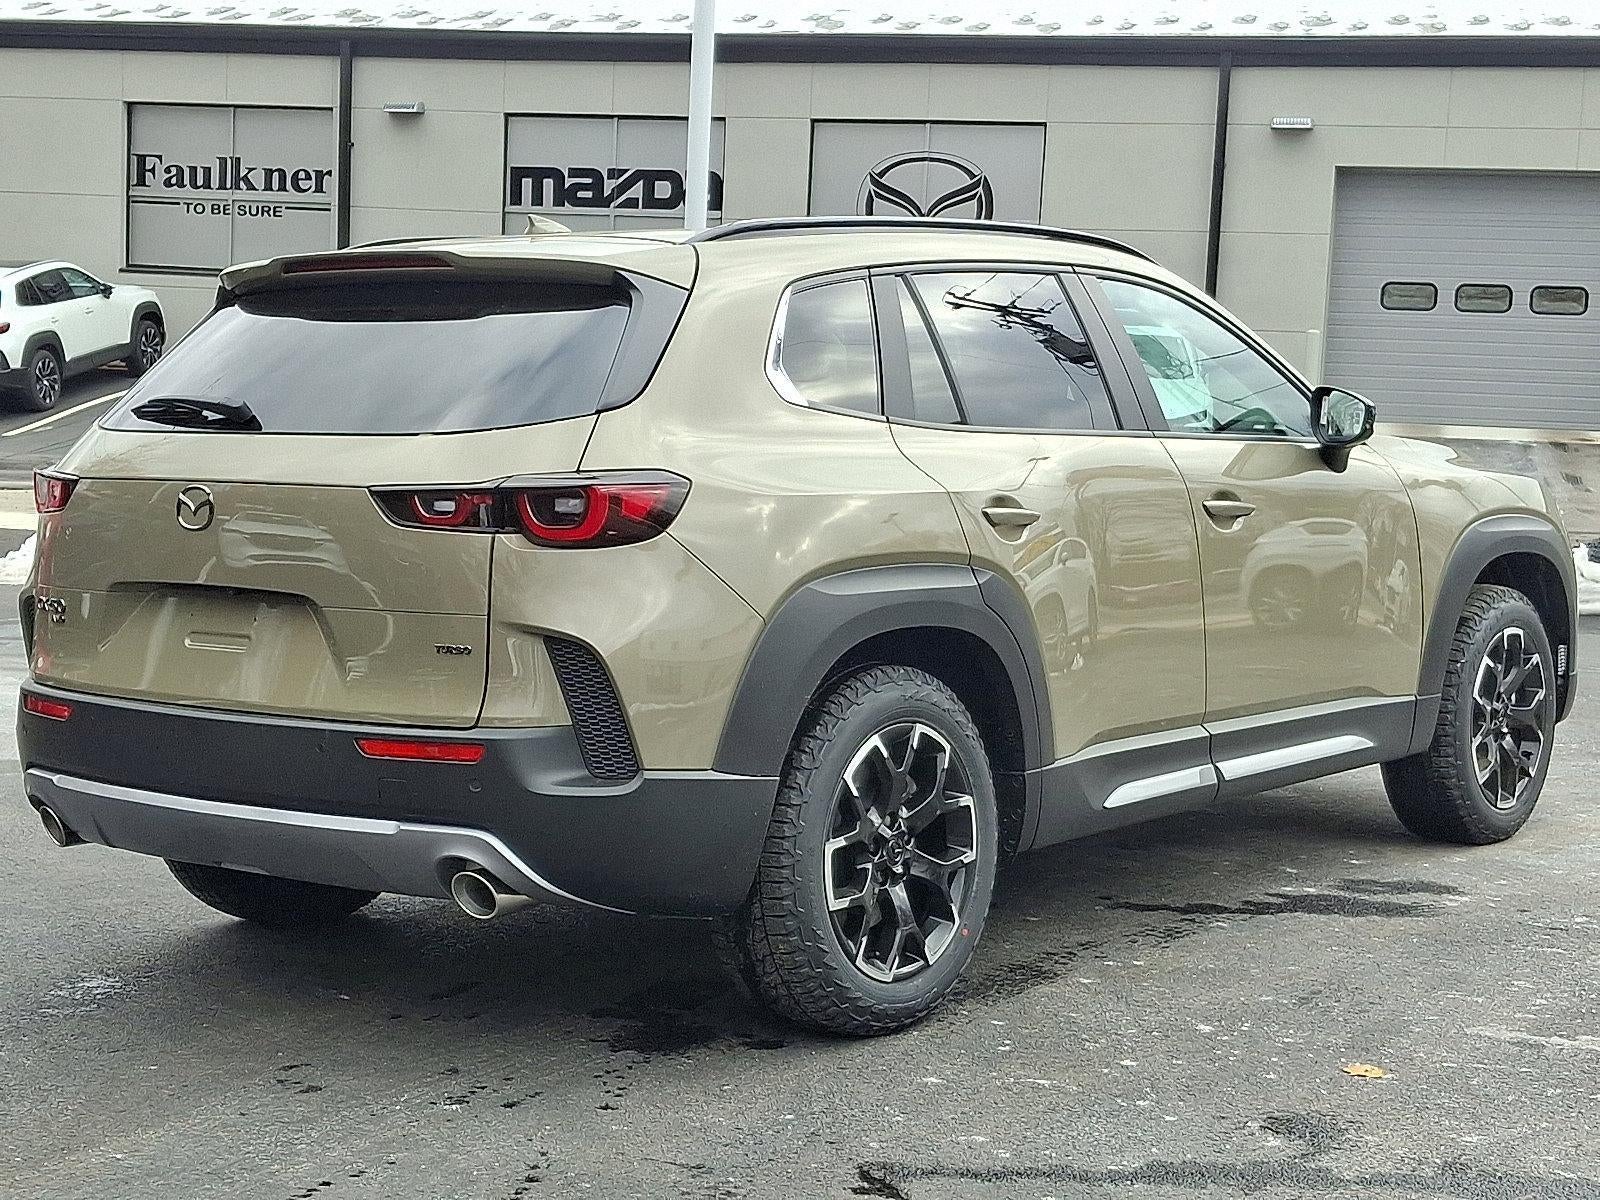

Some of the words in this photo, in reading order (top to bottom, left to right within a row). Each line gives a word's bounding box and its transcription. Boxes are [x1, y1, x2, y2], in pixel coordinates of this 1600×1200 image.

[131, 153, 333, 194] Faulkner
[184, 202, 206, 215] TO
[210, 203, 231, 215] BE
[236, 204, 283, 217] SURE
